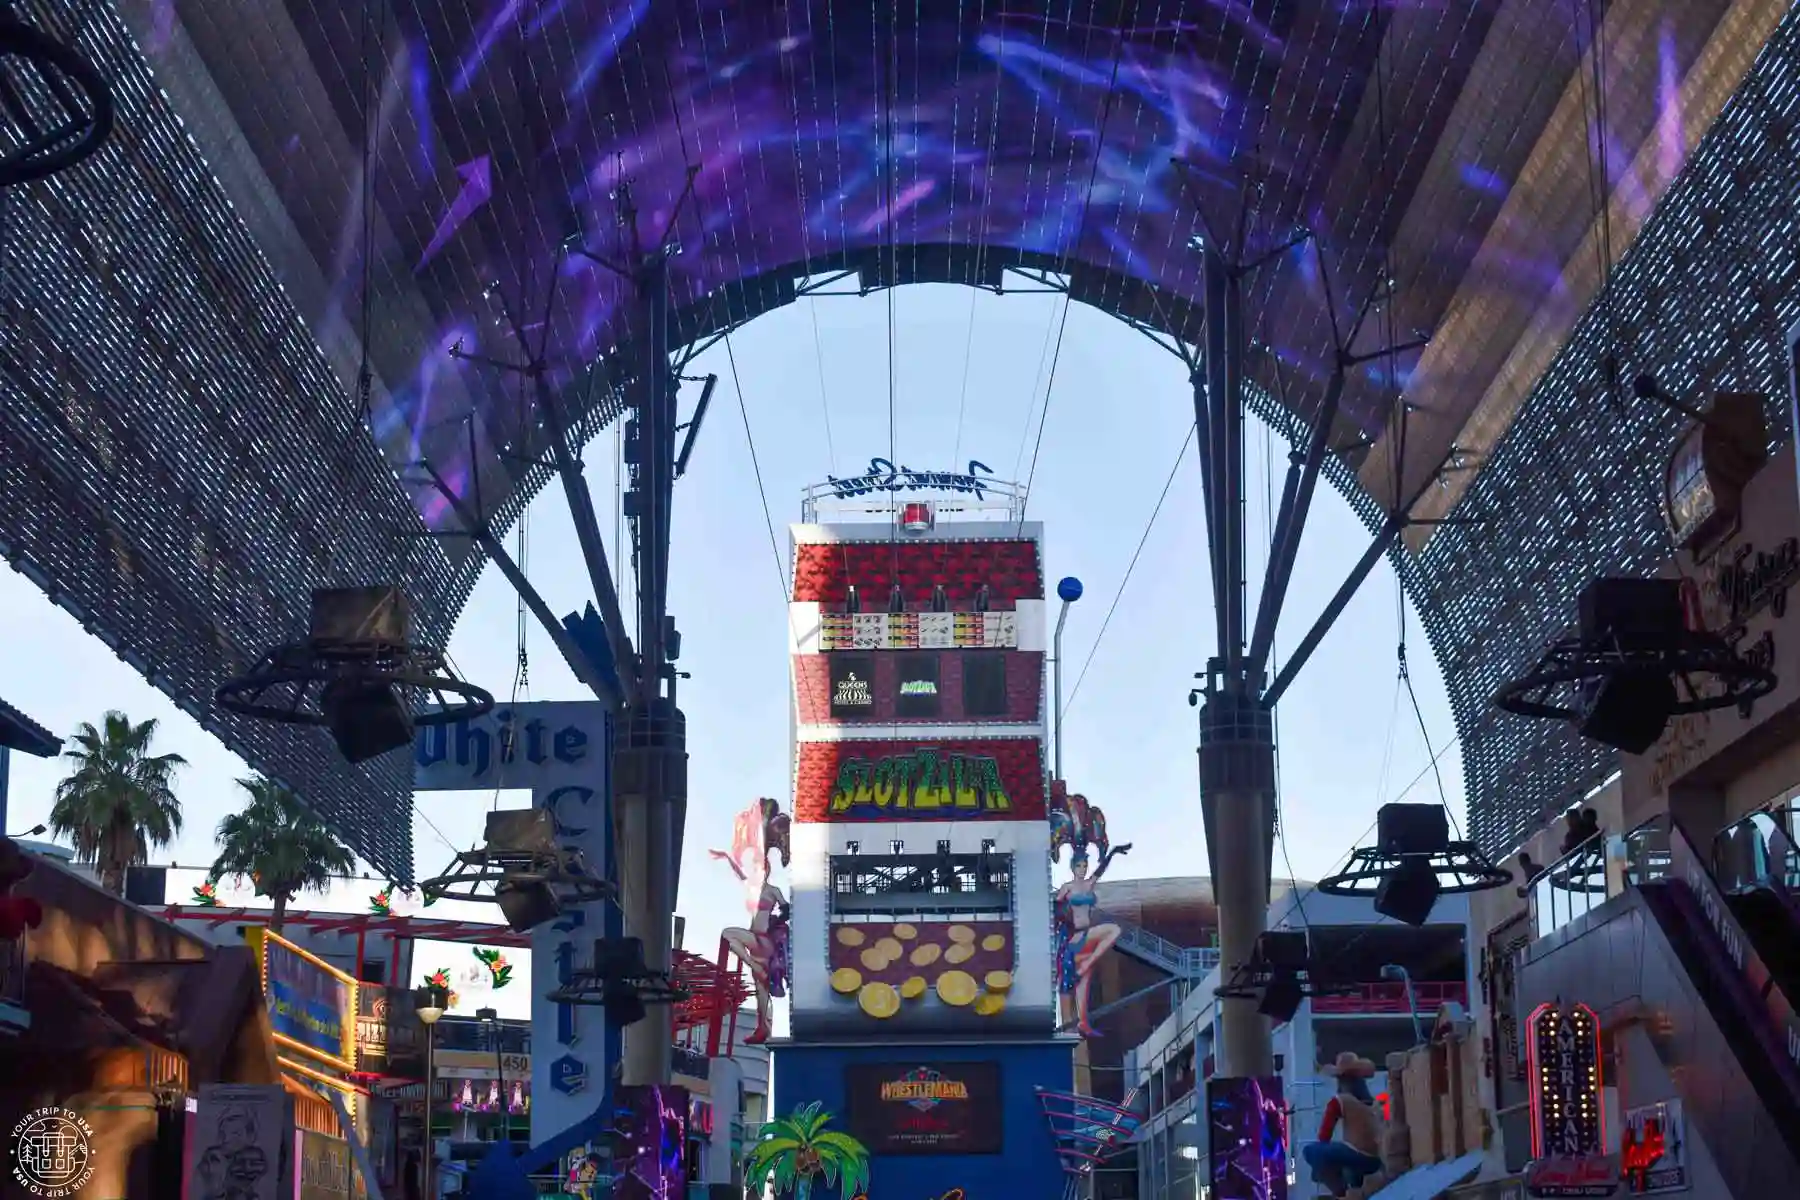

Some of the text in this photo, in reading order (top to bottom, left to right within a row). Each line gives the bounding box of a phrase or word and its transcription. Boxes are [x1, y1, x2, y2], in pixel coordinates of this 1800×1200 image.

[838, 681, 867, 690] QUEENS
[832, 748, 1012, 814] SLOTZILLA
[1721, 917, 1743, 970] FUN
[503, 1055, 529, 1073] 450
[880, 1078, 968, 1100] WRESTLEMANIA
[1556, 1018, 1579, 1152] AMERICAN
